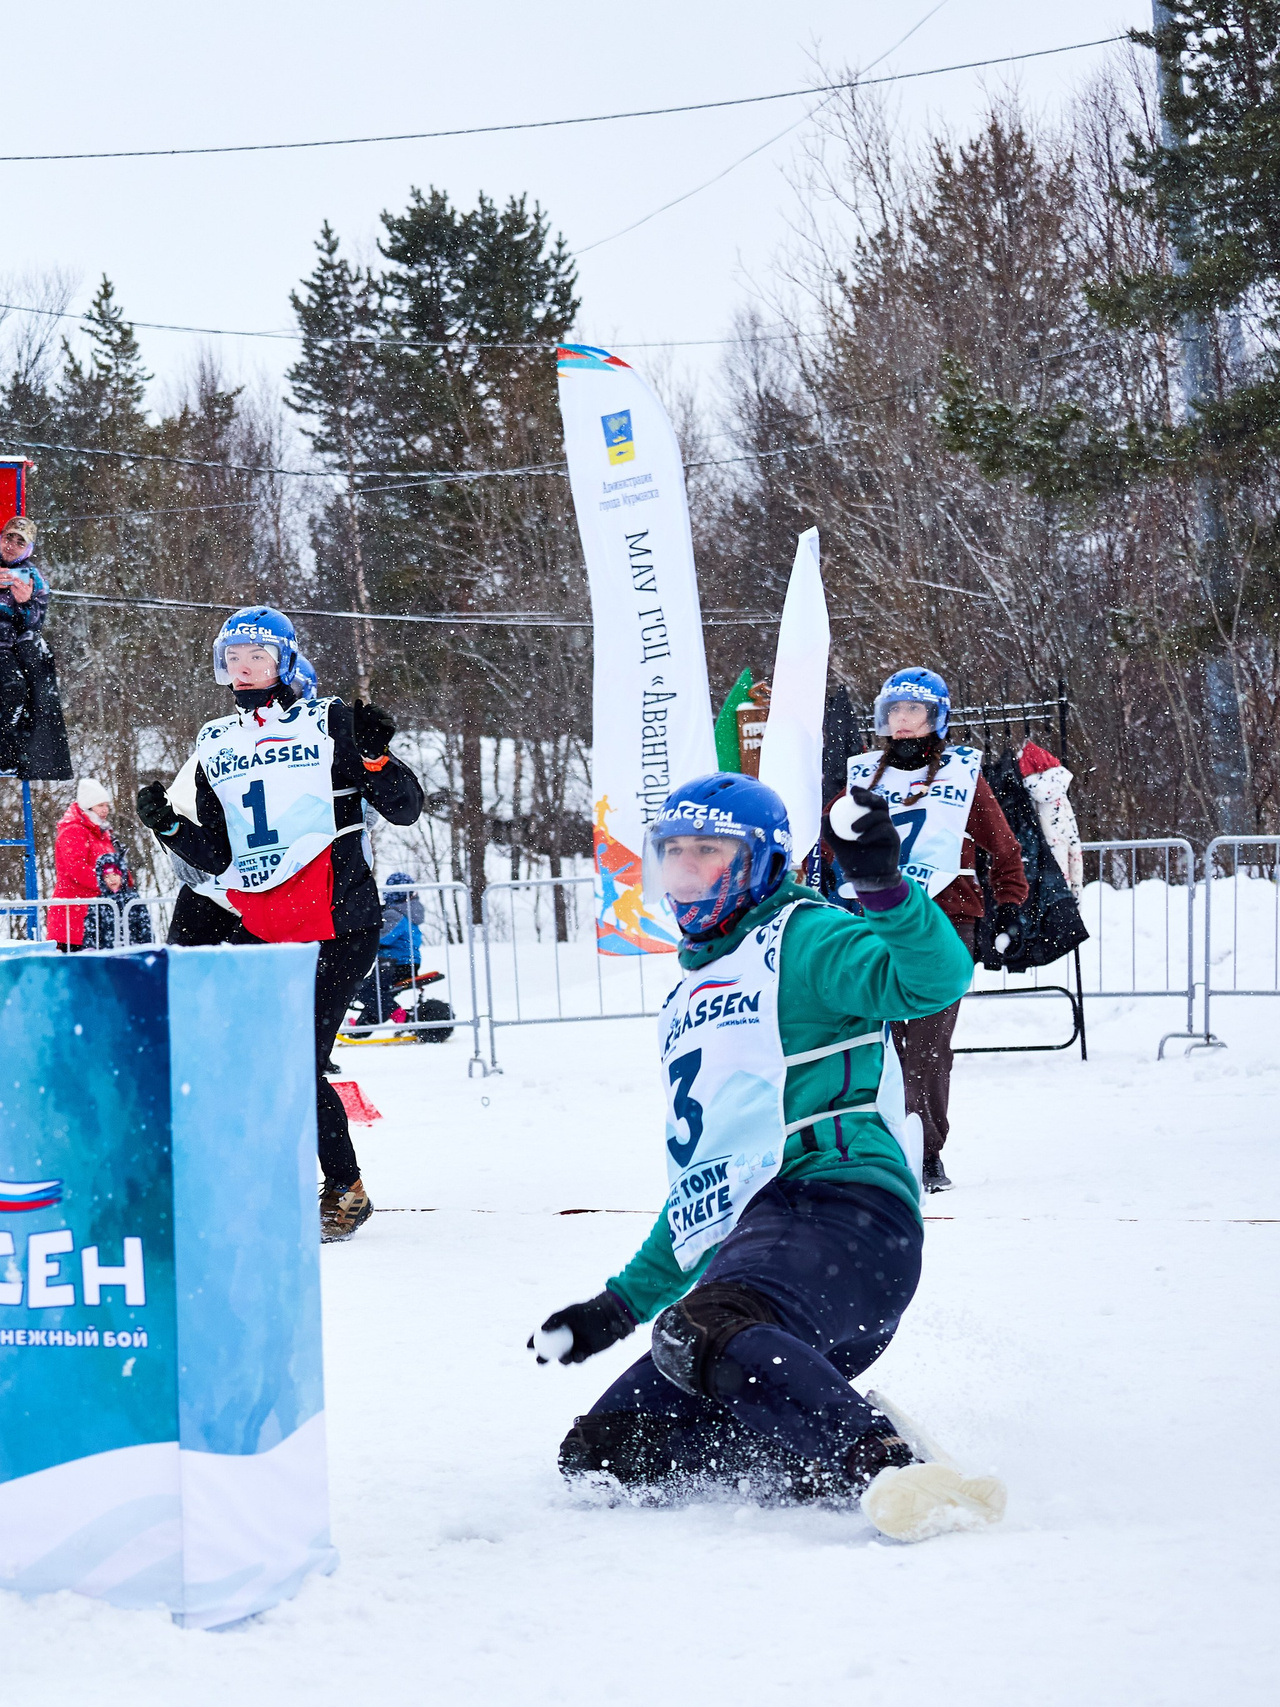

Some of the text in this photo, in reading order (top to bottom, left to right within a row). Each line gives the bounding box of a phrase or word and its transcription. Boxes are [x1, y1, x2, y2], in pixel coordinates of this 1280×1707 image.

[624, 529, 658, 594] МАУ
[638, 606, 672, 664] ГСЦ
[241, 779, 279, 849] 1
[667, 1048, 703, 1168] 3
[102, 1326, 149, 1349] БОЙ
